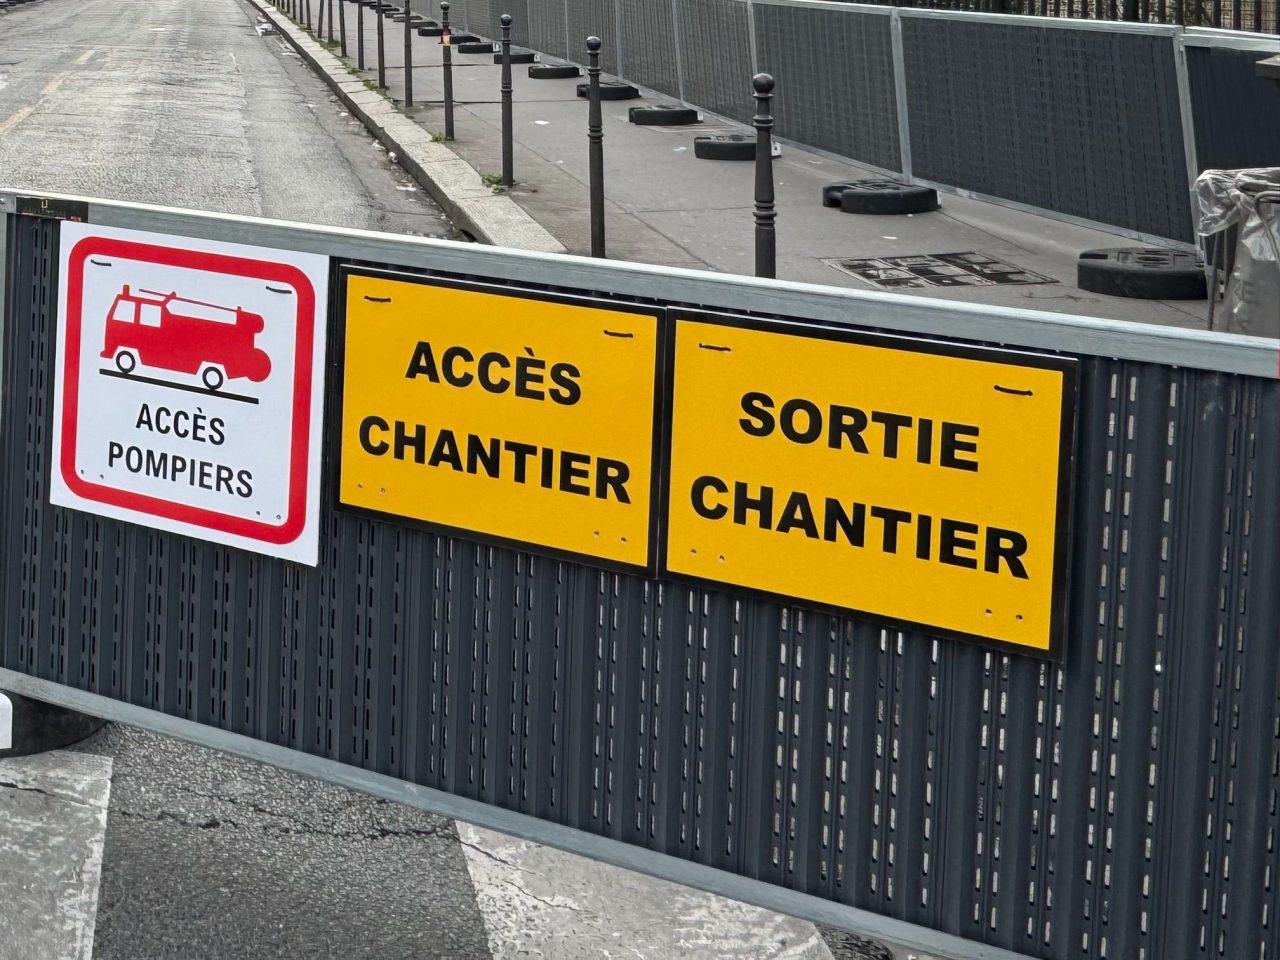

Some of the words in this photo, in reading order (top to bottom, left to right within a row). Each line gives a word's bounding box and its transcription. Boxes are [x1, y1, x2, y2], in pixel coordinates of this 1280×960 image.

[405, 340, 582, 406] ACCÈS
[135, 403, 225, 446] ACCÈS
[358, 415, 631, 505] CHANTIER
[738, 391, 980, 473] SORTIE
[108, 441, 254, 499] POMPIERS
[690, 475, 1030, 580] CHANTIER
